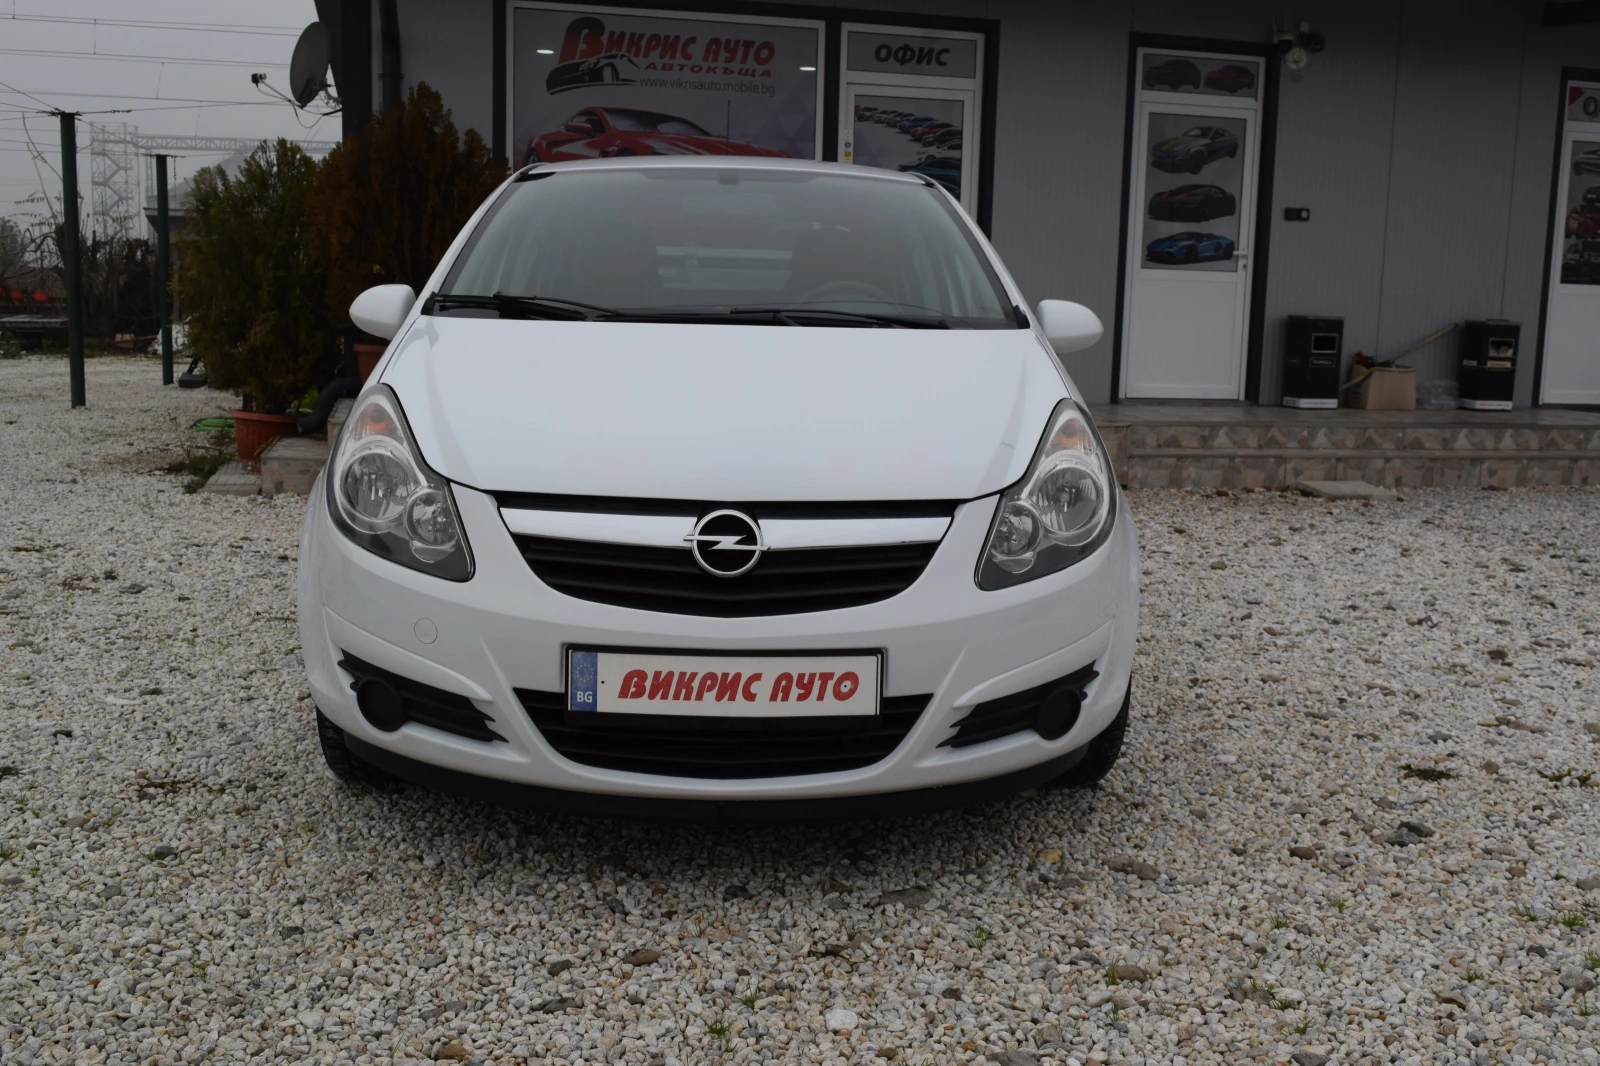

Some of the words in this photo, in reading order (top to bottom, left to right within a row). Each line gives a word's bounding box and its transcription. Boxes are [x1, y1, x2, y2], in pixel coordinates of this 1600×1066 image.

[558, 16, 697, 65] ВИКРИС
[702, 37, 775, 67] АУТО
[874, 43, 950, 66] ОФИС
[644, 61, 772, 78] АВТОКЪЩА
[639, 76, 775, 97] www.vikrisauto.mobile.bg
[617, 668, 763, 703] ВИКРИС
[769, 670, 860, 703] АУТО
[576, 690, 594, 704] BG
